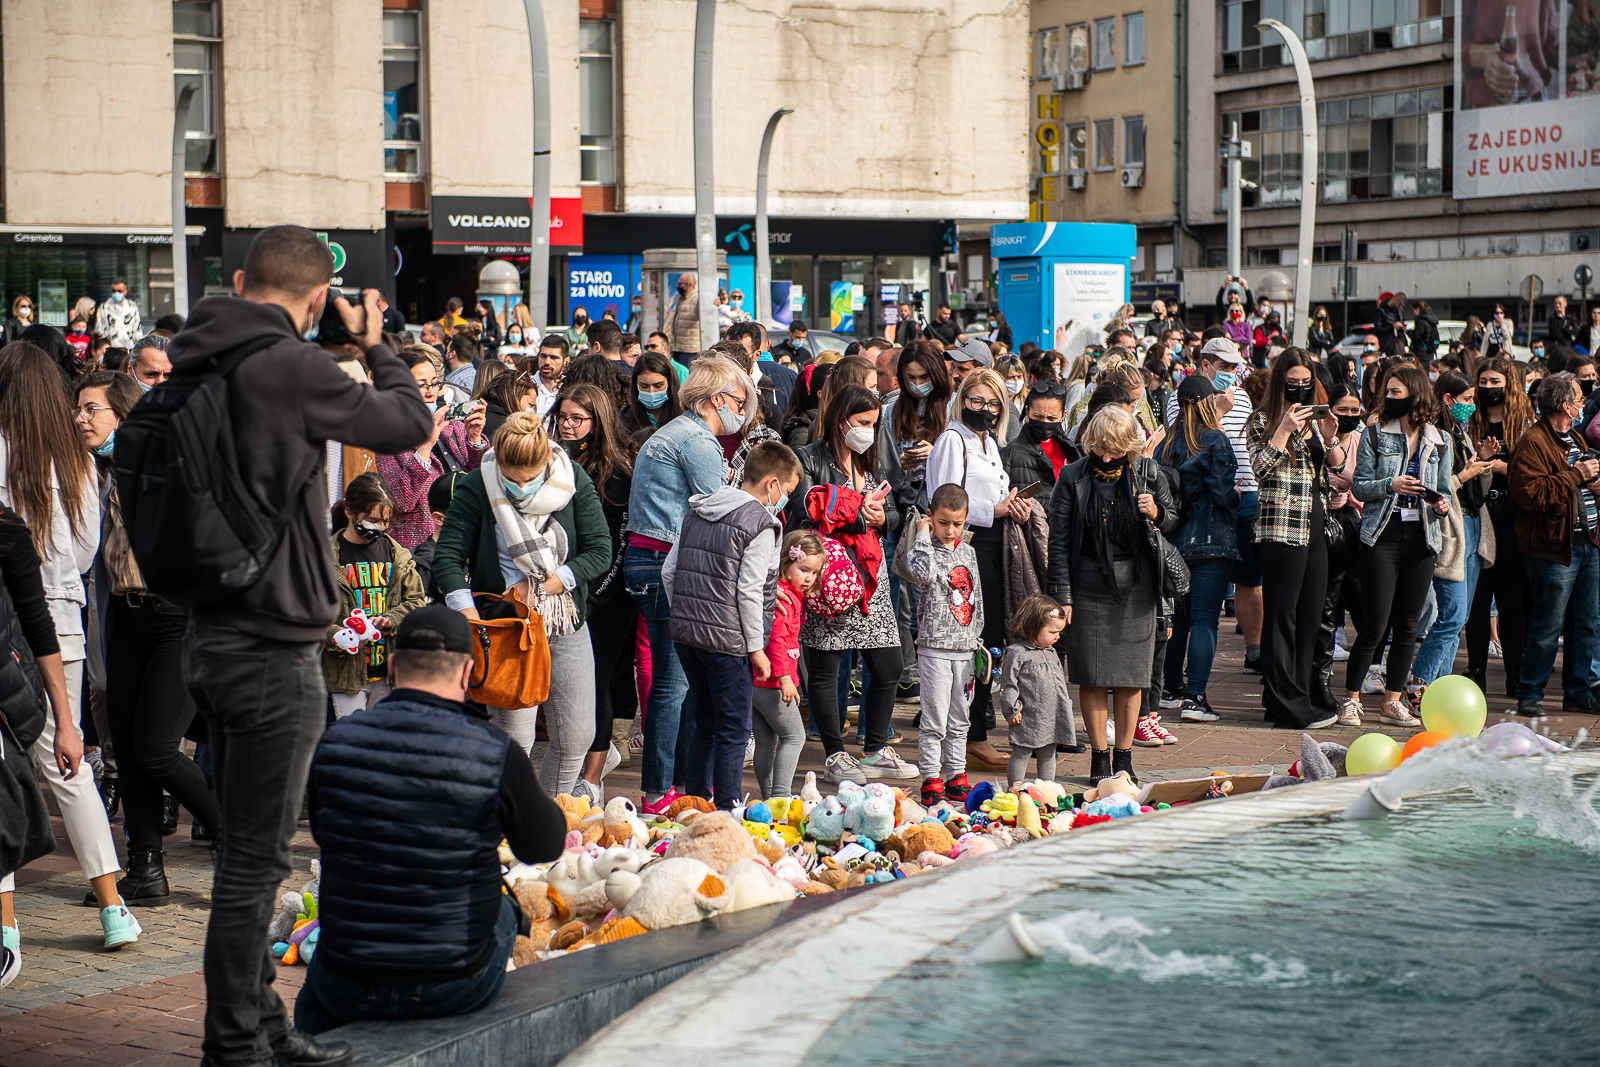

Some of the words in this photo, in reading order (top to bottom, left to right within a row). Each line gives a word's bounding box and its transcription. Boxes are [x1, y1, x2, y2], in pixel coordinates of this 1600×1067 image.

[1467, 124, 1563, 151] ZAJEDNO
[1467, 158, 1490, 178] JE
[1498, 147, 1600, 175] UKUSNIJE
[447, 214, 531, 228] VOLCANO
[14, 232, 64, 243] Cosmetics
[751, 231, 793, 244] tenor
[464, 244, 489, 254] betting
[495, 244, 517, 253] casino
[570, 270, 613, 285] STARO
[1065, 269, 1098, 277] STAMBENI
[570, 286, 586, 298] za
[587, 284, 626, 298] NOVO
